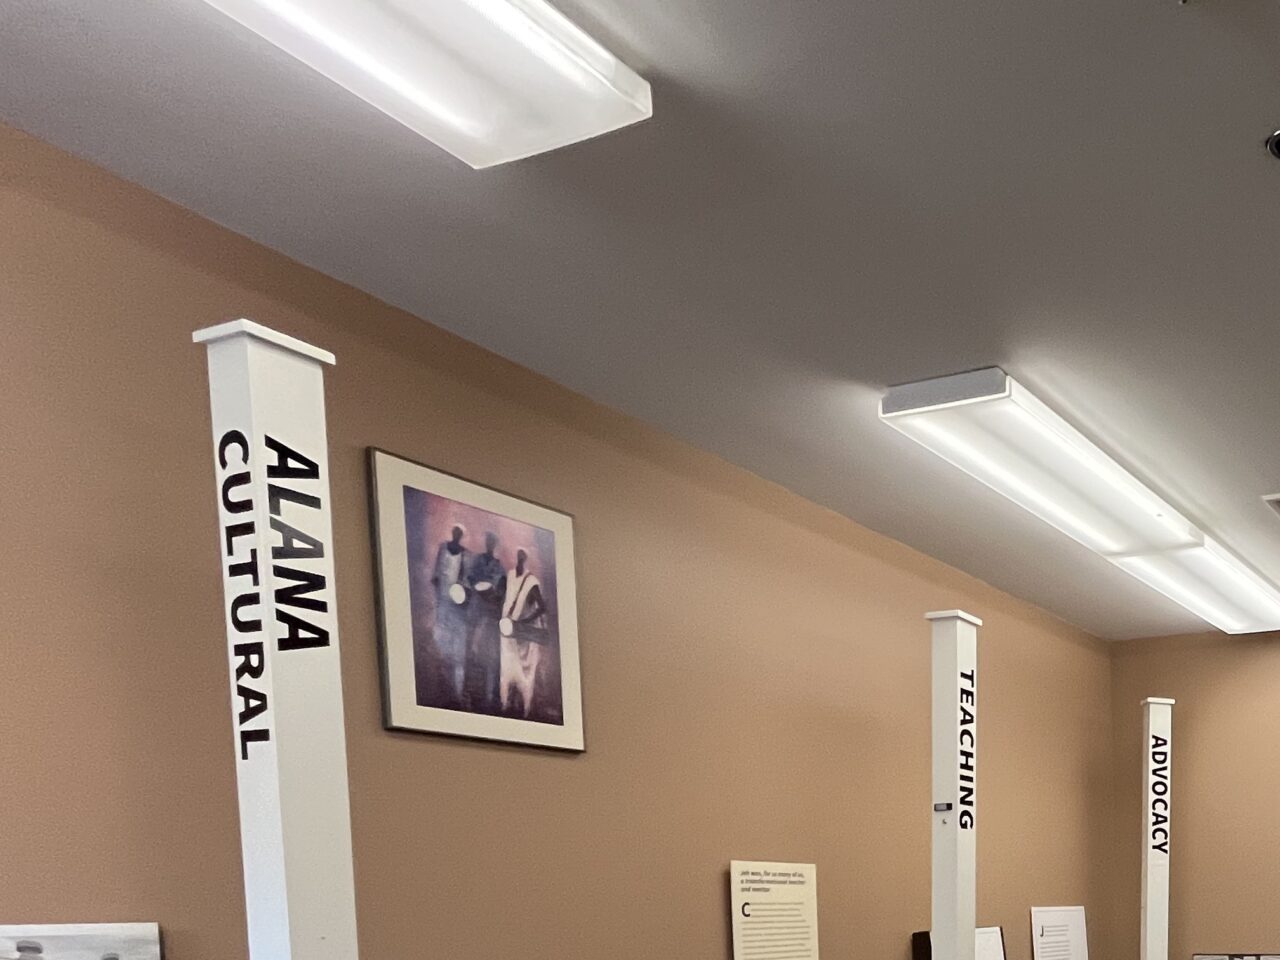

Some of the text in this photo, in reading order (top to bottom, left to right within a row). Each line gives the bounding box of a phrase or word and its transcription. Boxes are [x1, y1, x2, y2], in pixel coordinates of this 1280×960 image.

[218, 429, 271, 760] CULTURAL
[264, 434, 331, 652] ALANA
[959, 669, 975, 830] TEACHING
[1151, 734, 1169, 855] ADVOCACY
